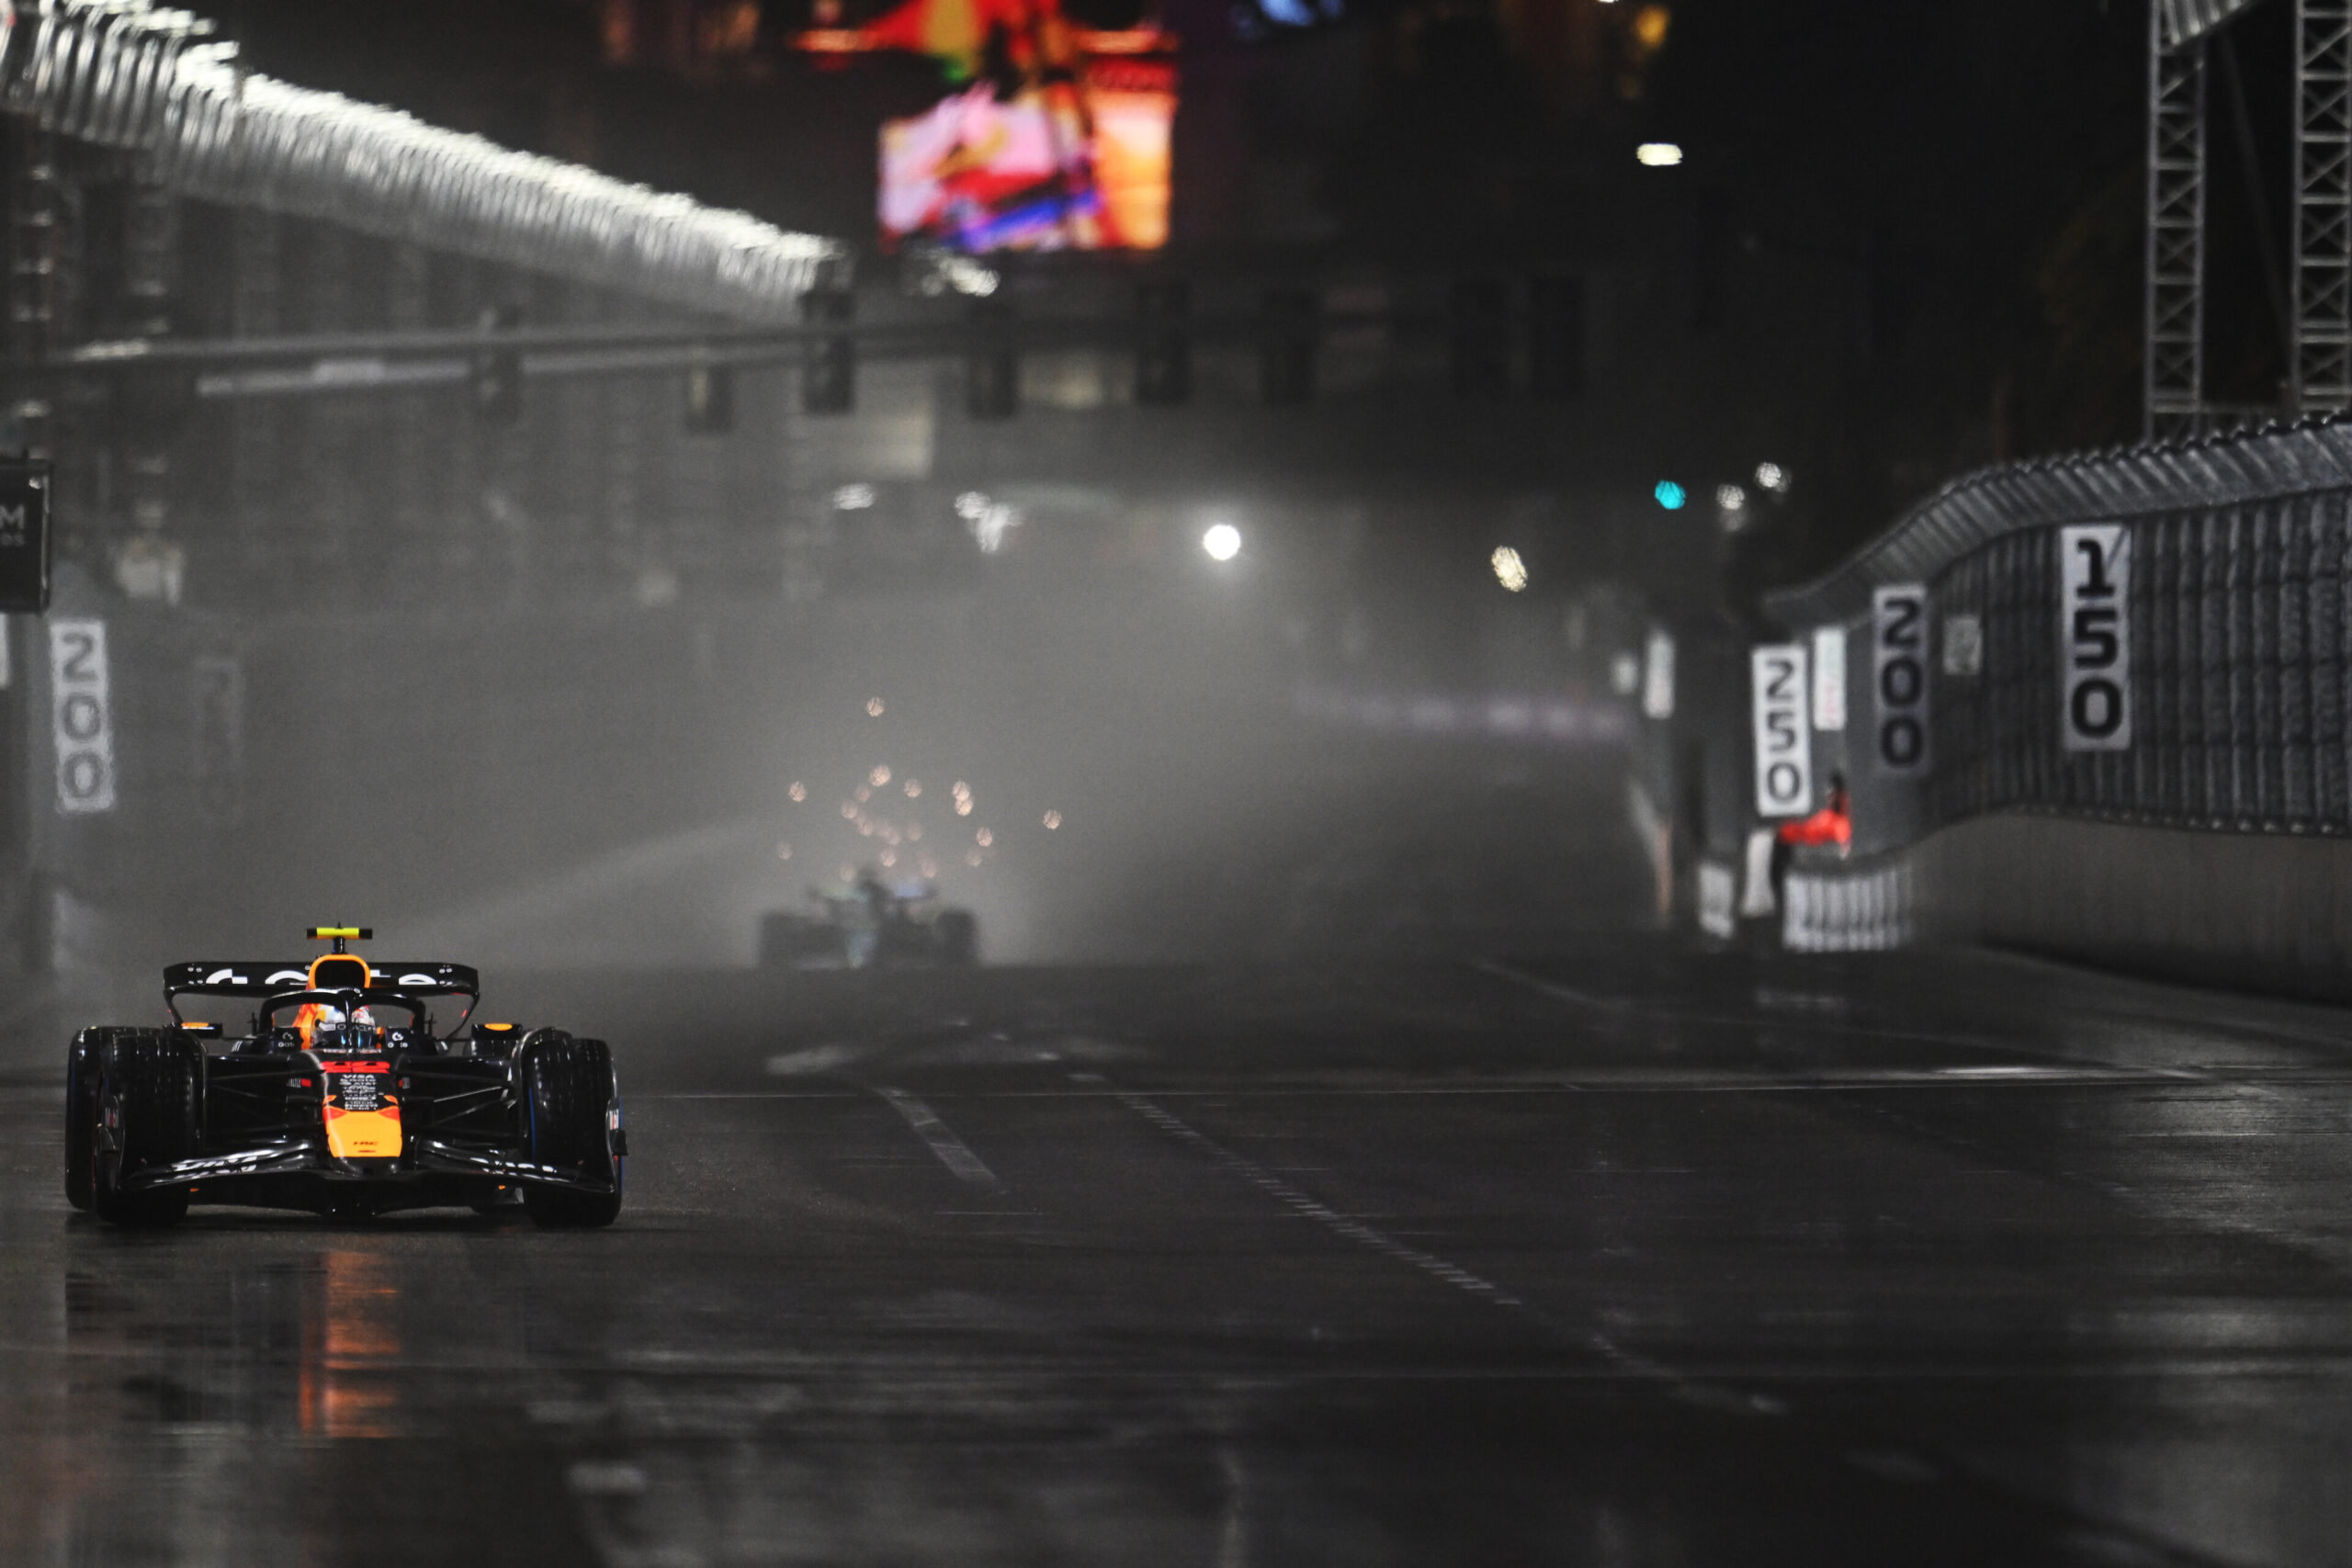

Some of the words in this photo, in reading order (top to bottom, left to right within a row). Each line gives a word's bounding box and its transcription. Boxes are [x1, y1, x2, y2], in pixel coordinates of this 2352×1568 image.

[62, 632, 103, 799] 200
[1882, 599, 1923, 769] 200
[2072, 538, 2124, 739] 150
[1765, 659, 1801, 801] 250
